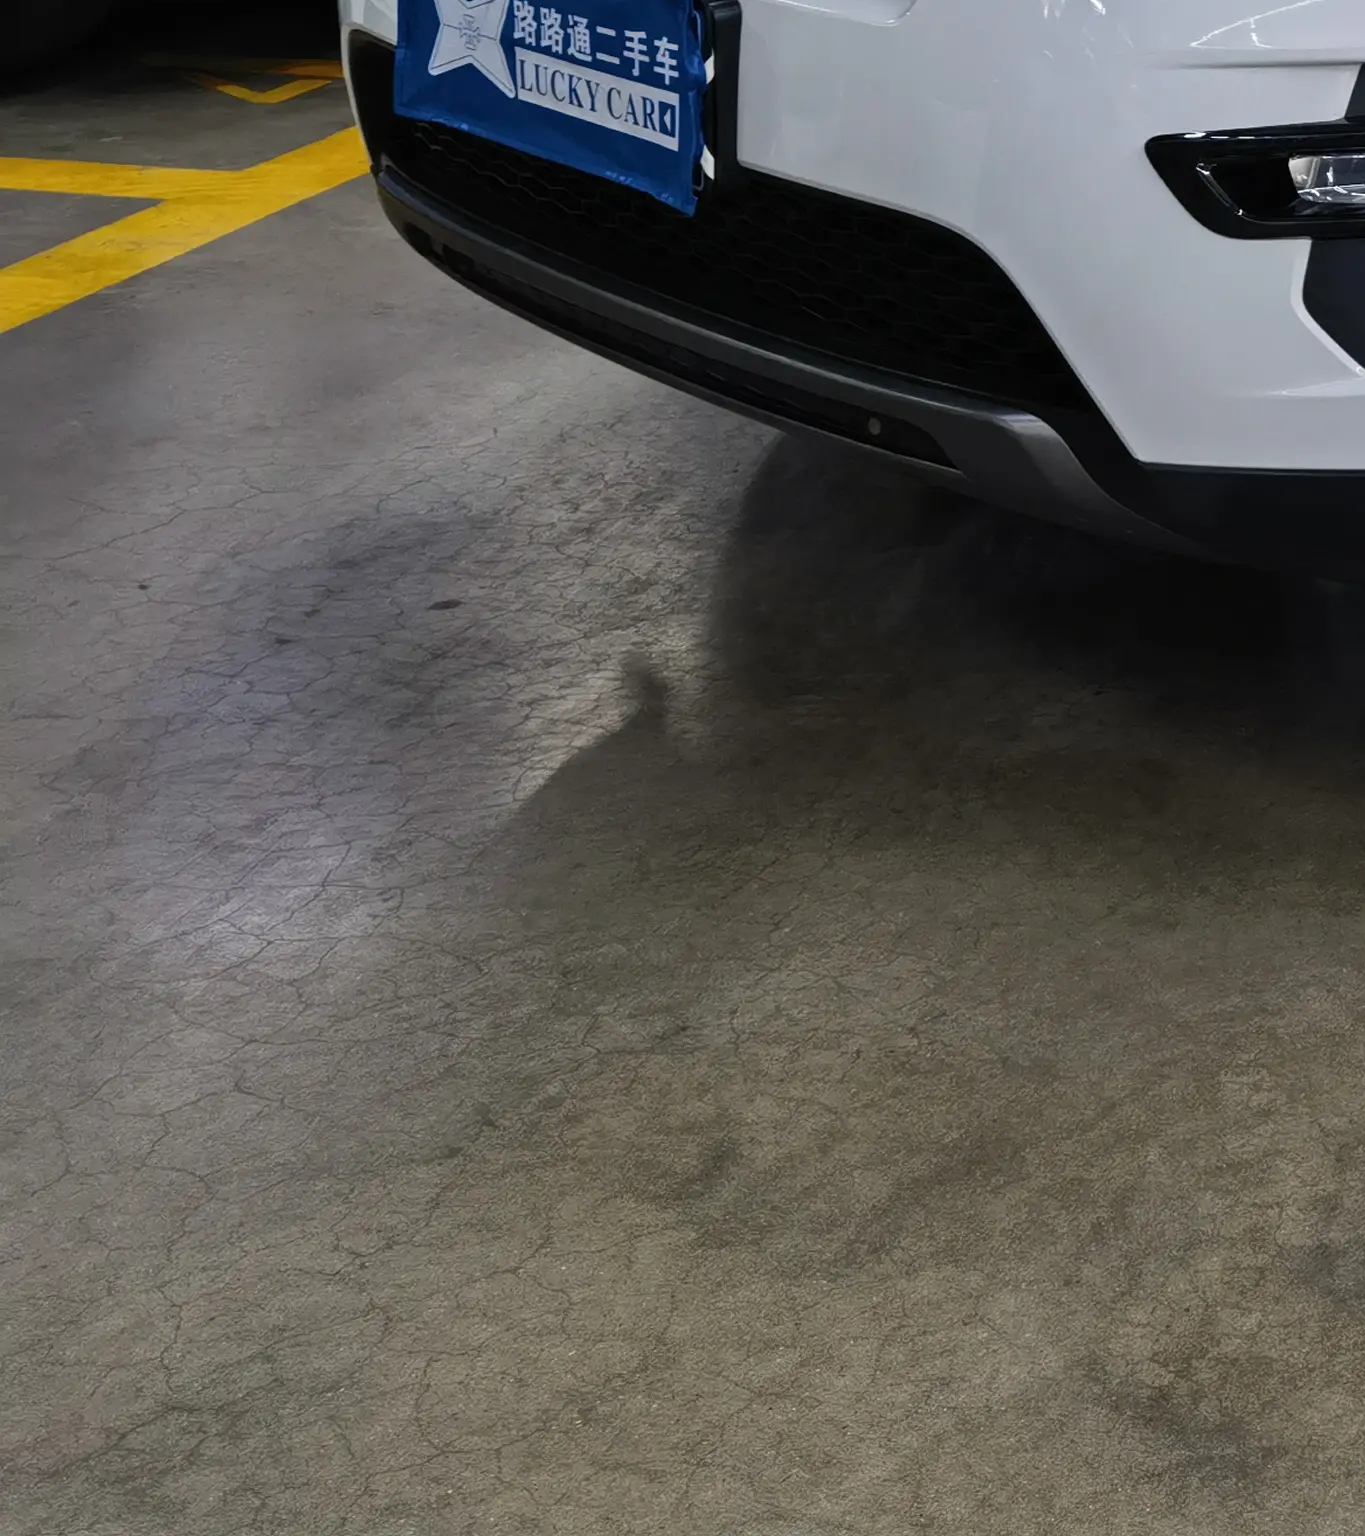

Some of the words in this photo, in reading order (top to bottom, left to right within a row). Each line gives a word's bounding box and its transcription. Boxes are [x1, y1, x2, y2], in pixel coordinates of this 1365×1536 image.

[513, 0, 679, 85] 路路通二手车
[518, 59, 600, 112] LUCKY
[606, 87, 658, 133] CAR
